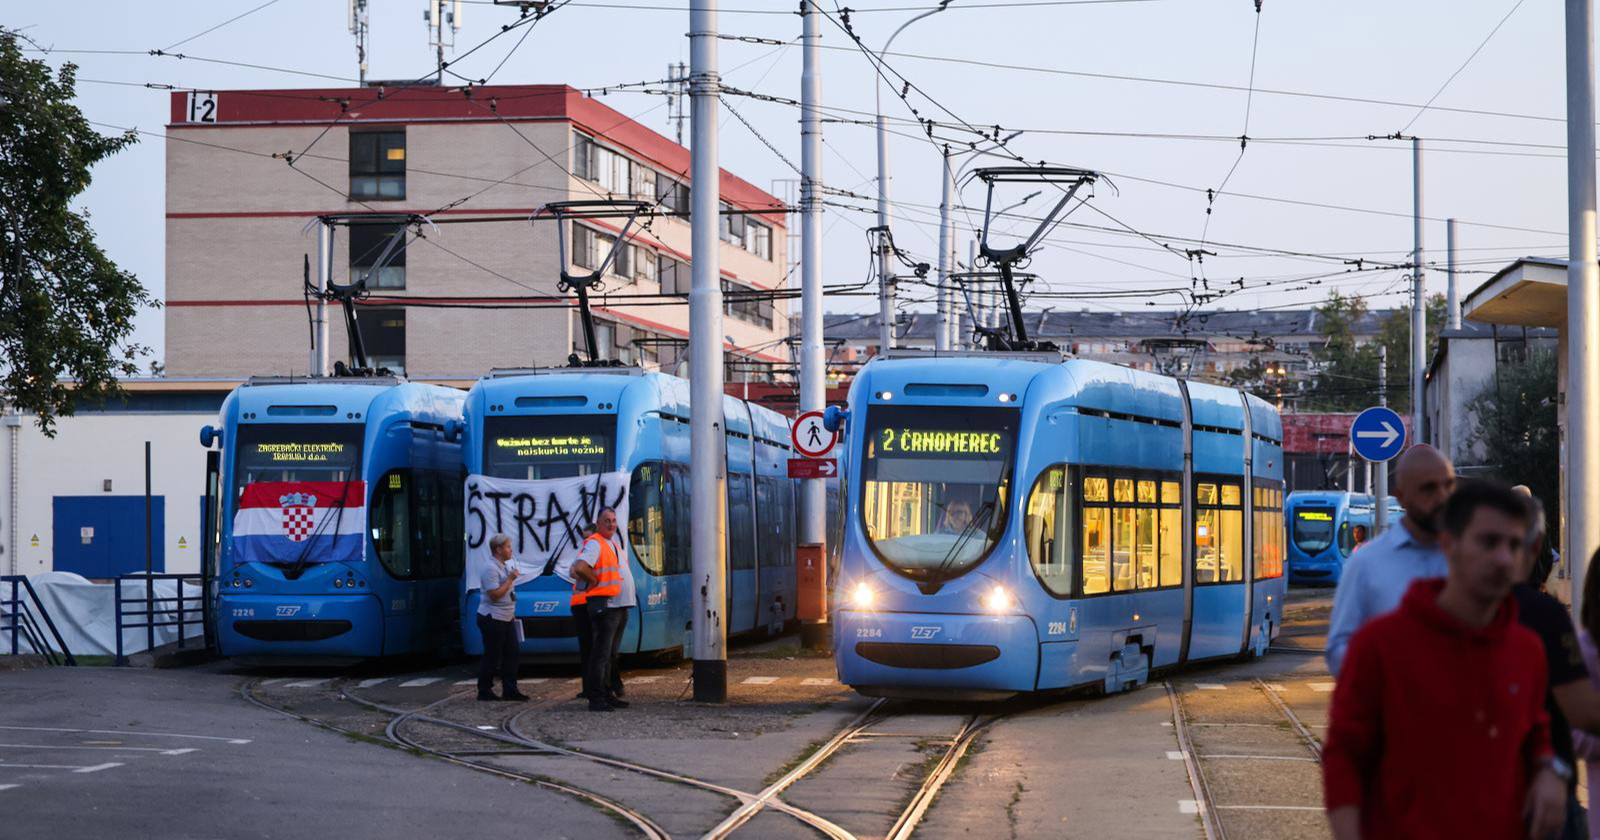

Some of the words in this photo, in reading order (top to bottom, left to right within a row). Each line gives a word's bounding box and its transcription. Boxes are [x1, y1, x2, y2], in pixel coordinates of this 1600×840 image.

[531, 437, 550, 446] bez
[580, 435, 591, 445] je
[883, 428, 894, 451] 2
[900, 428, 1001, 453] ČRNOMEREC
[257, 442, 301, 453] ZAGREBAČKI
[303, 442, 344, 453] ELEKTRIČNI
[572, 445, 604, 455] vožnja
[276, 605, 302, 617] ZET
[533, 601, 560, 612] ZET
[232, 608, 255, 617] 2226
[856, 628, 882, 638] 2284
[911, 626, 942, 639] ZET
[1048, 621, 1067, 635] 2284
